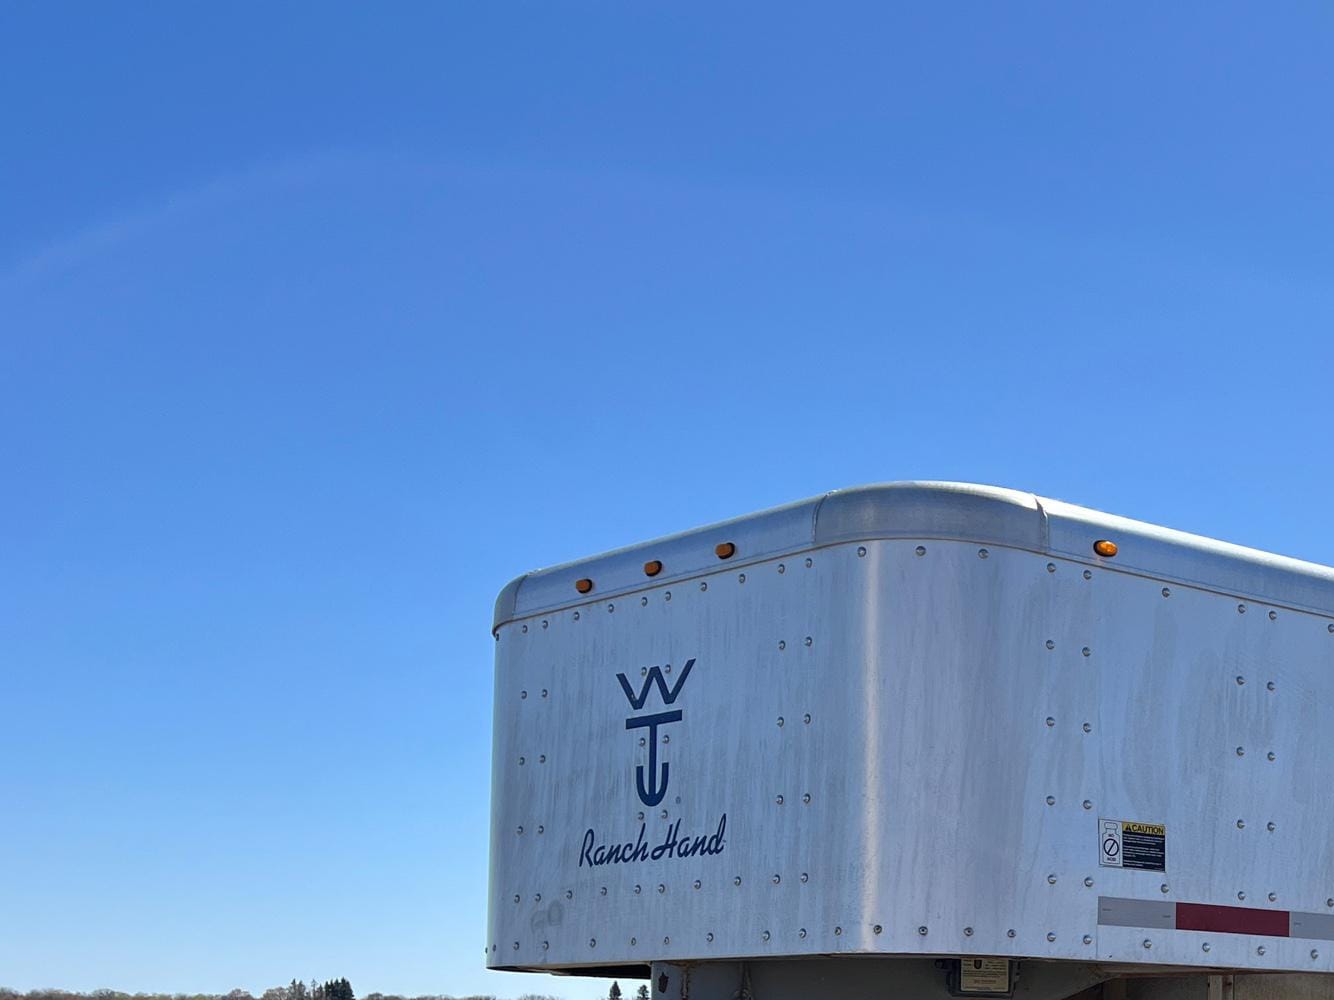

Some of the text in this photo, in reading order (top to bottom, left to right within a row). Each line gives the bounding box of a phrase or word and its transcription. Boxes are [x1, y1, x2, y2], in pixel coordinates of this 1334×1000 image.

[578, 812, 727, 868] Ranch Hand
[1132, 824, 1164, 834] CAUTION
